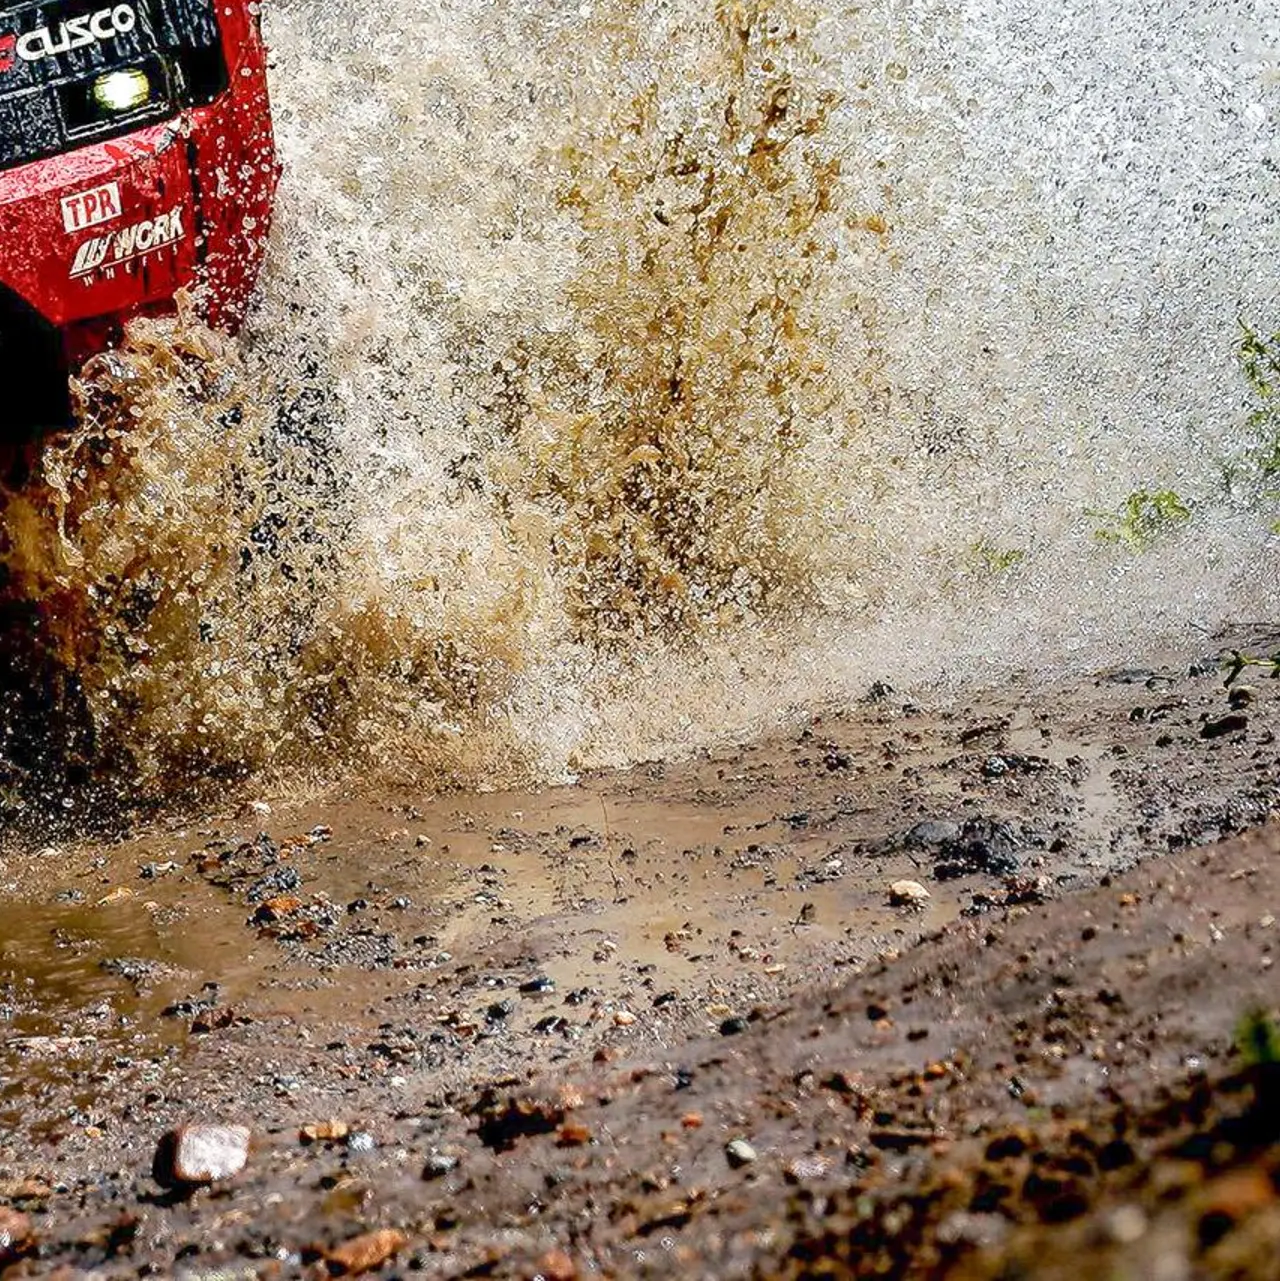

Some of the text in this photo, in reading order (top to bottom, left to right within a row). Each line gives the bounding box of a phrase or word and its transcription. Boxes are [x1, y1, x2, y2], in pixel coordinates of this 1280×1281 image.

[15, 3, 136, 61] CUSCO
[66, 188, 117, 228] TPR
[114, 205, 185, 260] WORK
